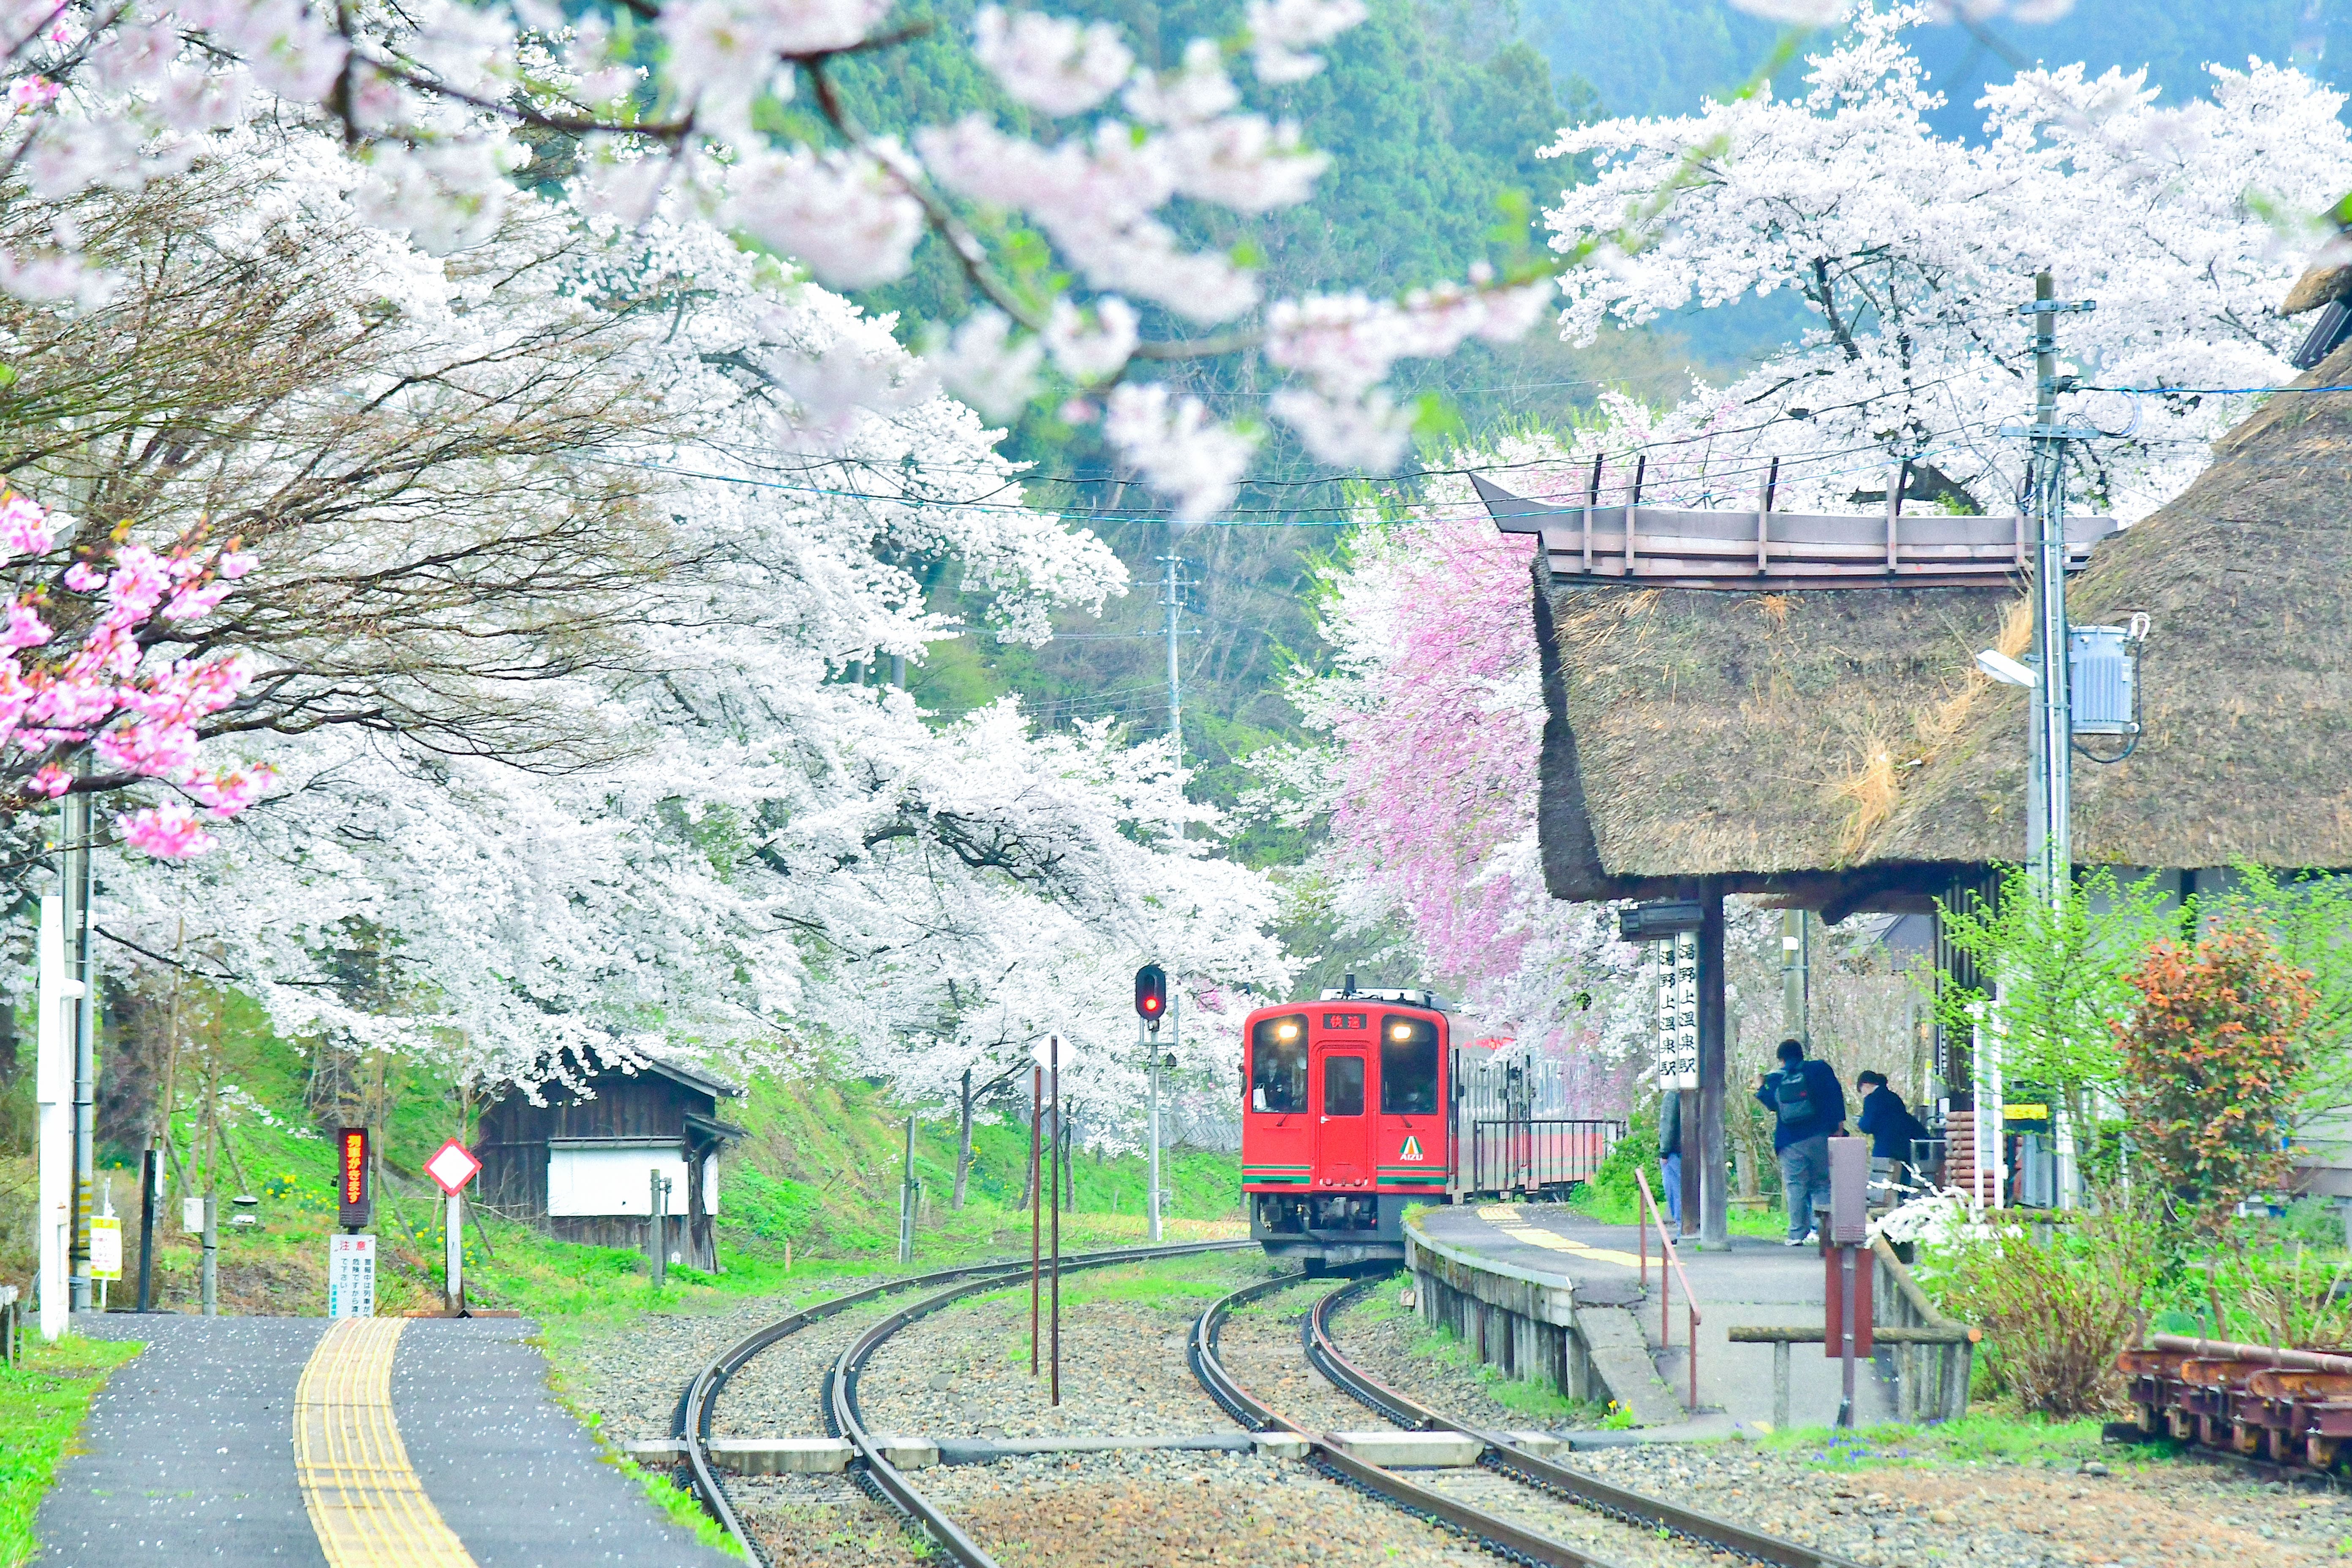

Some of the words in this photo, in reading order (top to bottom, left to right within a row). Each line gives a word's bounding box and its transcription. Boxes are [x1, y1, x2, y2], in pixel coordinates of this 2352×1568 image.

[1330, 1015, 1360, 1028] 快速
[1659, 950, 1676, 1076] 湯野上温泉駅
[1679, 943, 1696, 1073] 湯野上温泉駅
[347, 1134, 362, 1203] 列車がきます
